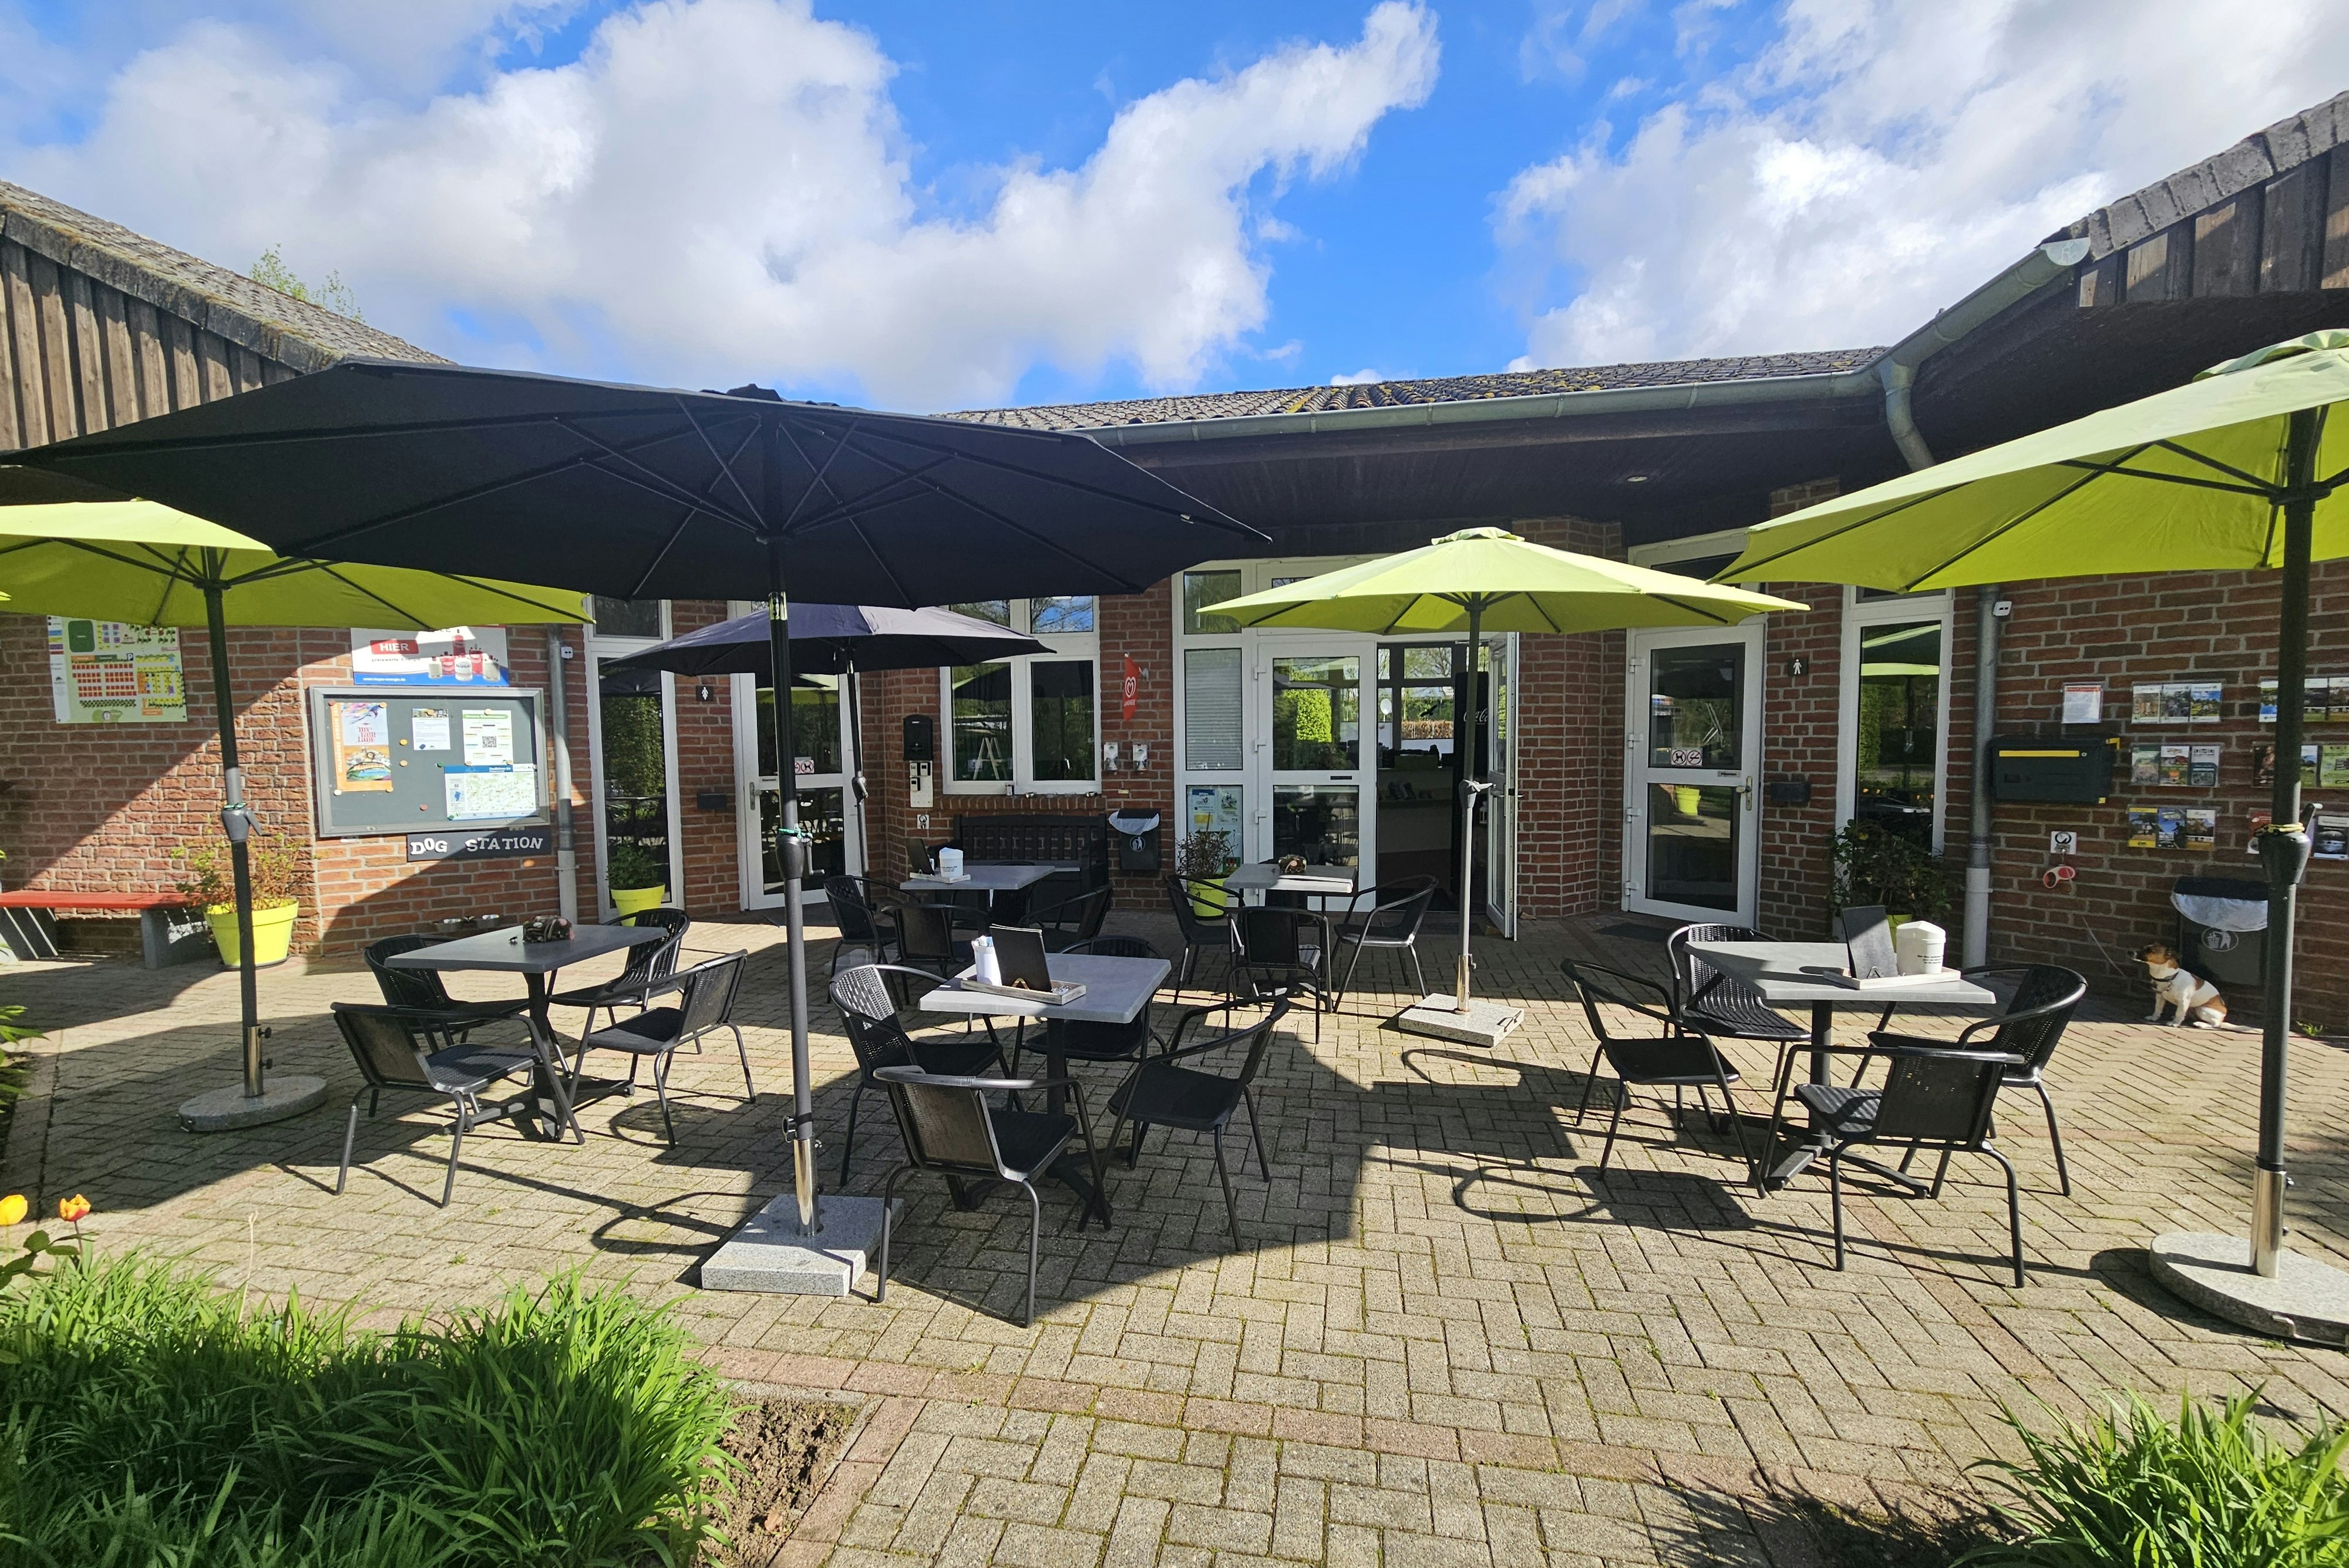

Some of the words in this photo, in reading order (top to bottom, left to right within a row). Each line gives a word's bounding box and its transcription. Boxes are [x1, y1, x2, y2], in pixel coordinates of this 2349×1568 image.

[379, 642, 410, 651] HIER
[410, 837, 447, 854] DOG
[465, 837, 543, 852] STATION
